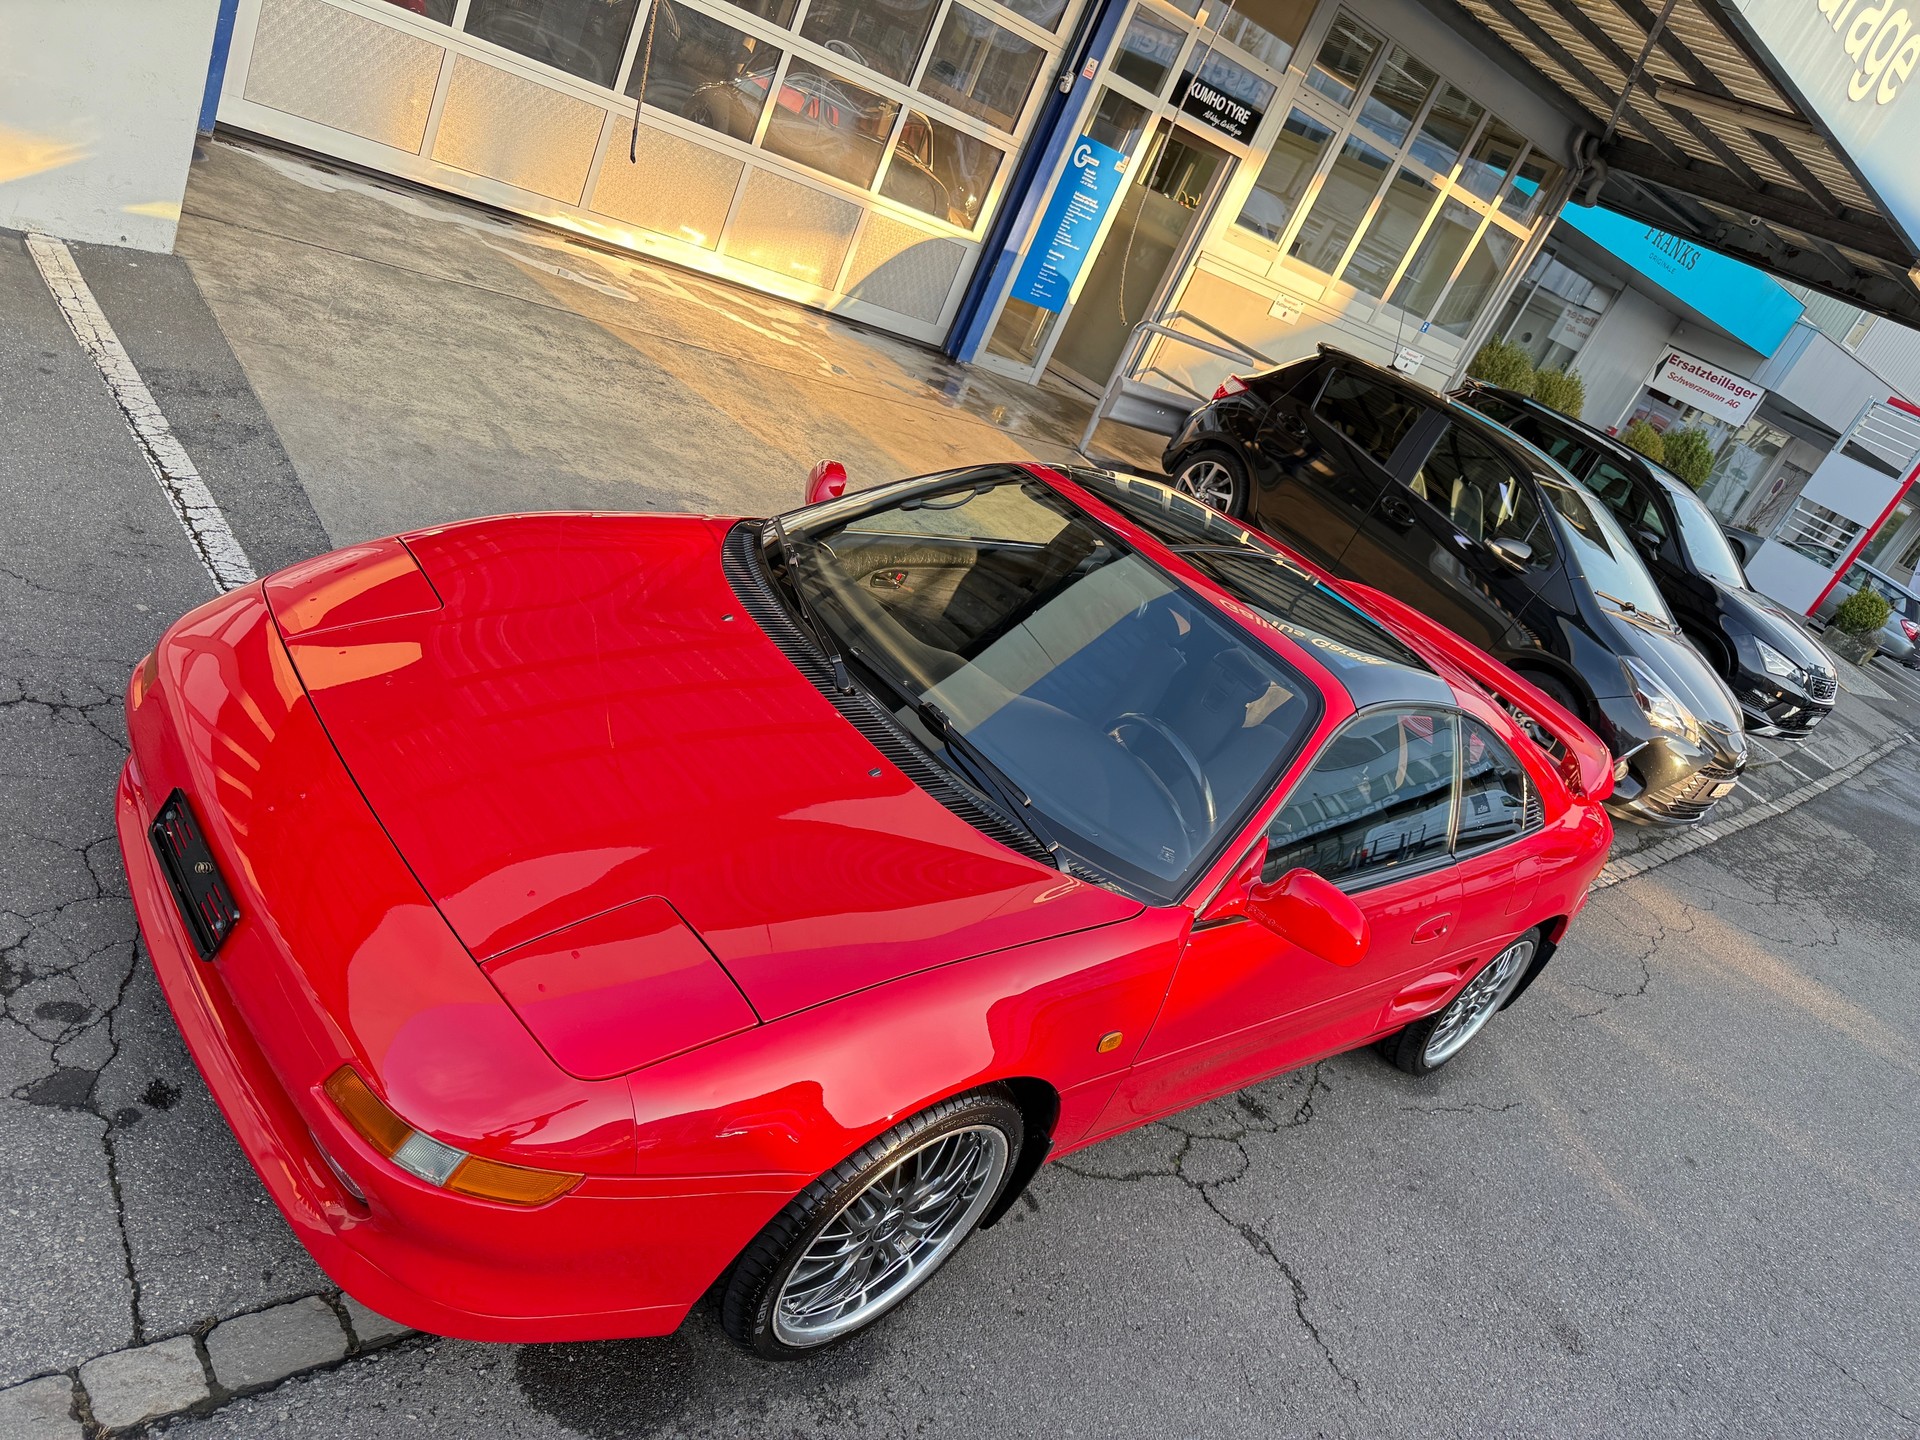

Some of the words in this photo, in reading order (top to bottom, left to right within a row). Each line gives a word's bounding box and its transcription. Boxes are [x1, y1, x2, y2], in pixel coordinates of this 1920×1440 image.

[1190, 82, 1227, 111] KUMHO
[1225, 101, 1252, 125] TYRE
[1649, 253, 1677, 275] ORIGINALE
[1667, 371, 1725, 403] Schwerzmann
[1725, 398, 1741, 409] AG
[1668, 354, 1758, 399] Ersatzteillager
